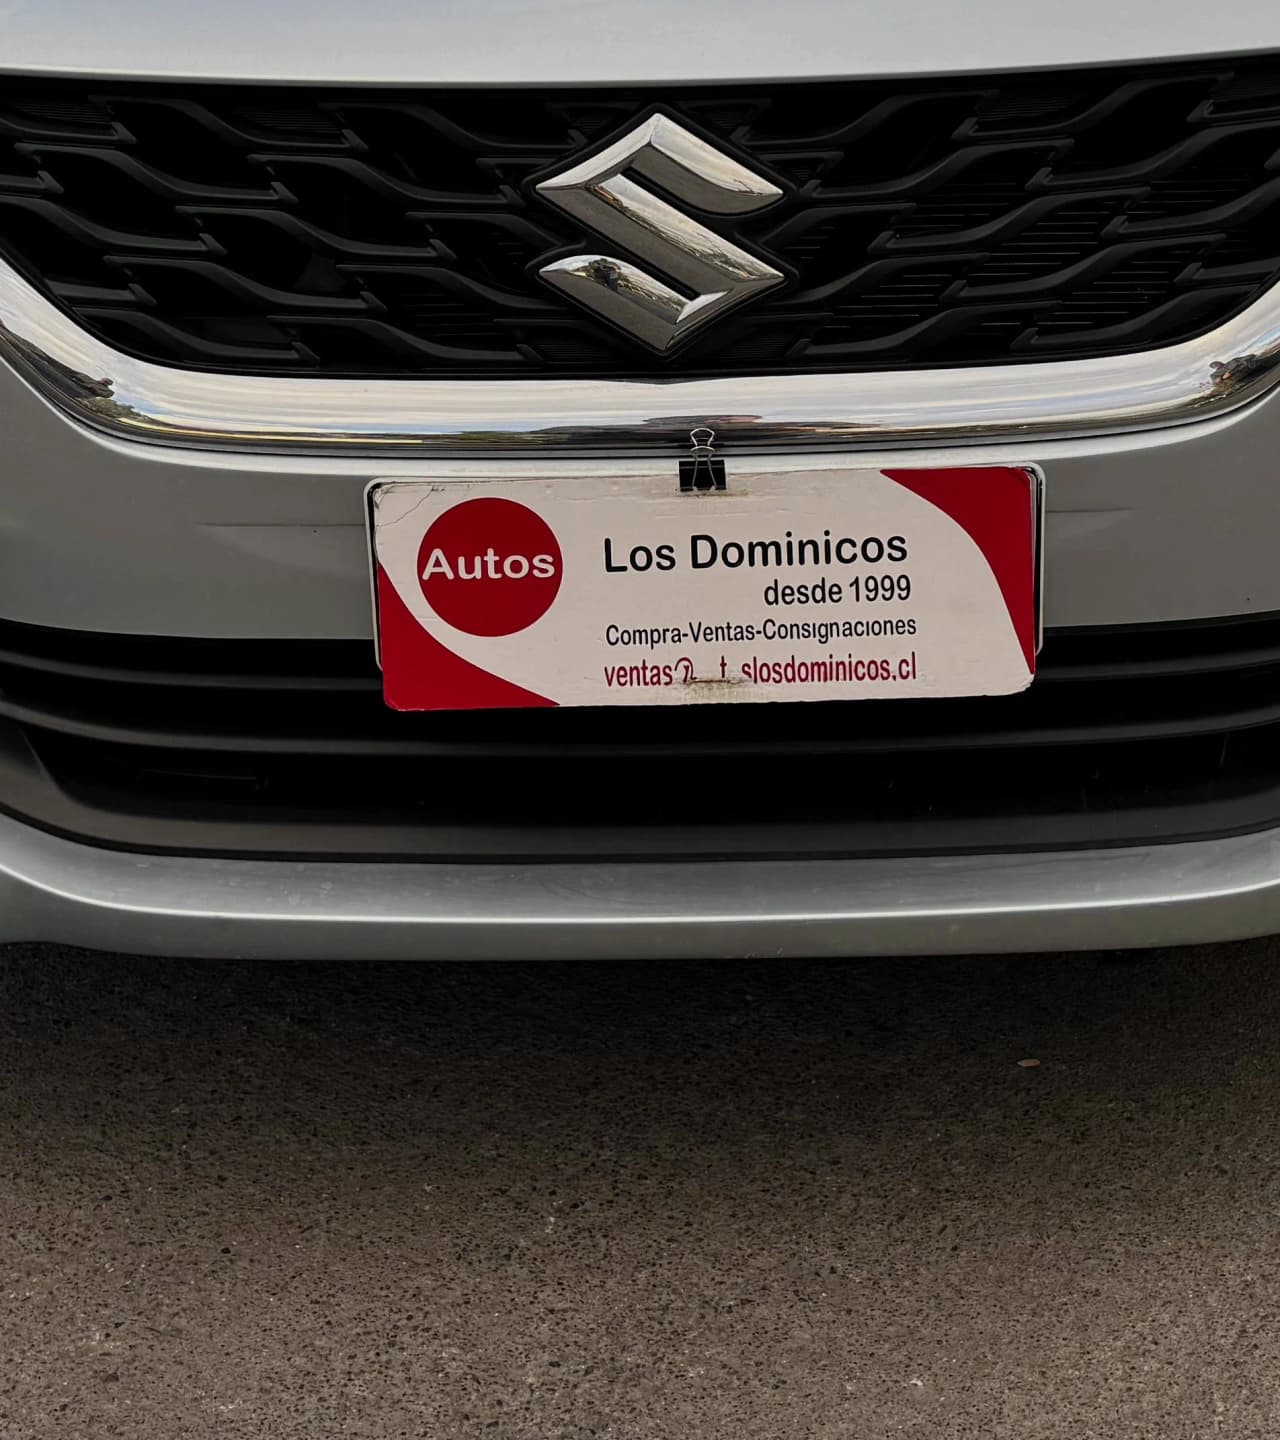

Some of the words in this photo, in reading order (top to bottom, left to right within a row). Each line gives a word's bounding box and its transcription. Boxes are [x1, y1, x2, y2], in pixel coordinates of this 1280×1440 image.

[422, 547, 556, 581] Autos
[604, 537, 677, 573] Los
[691, 530, 908, 570] Dominicos
[764, 578, 843, 606] desde
[848, 574, 912, 603] 1999
